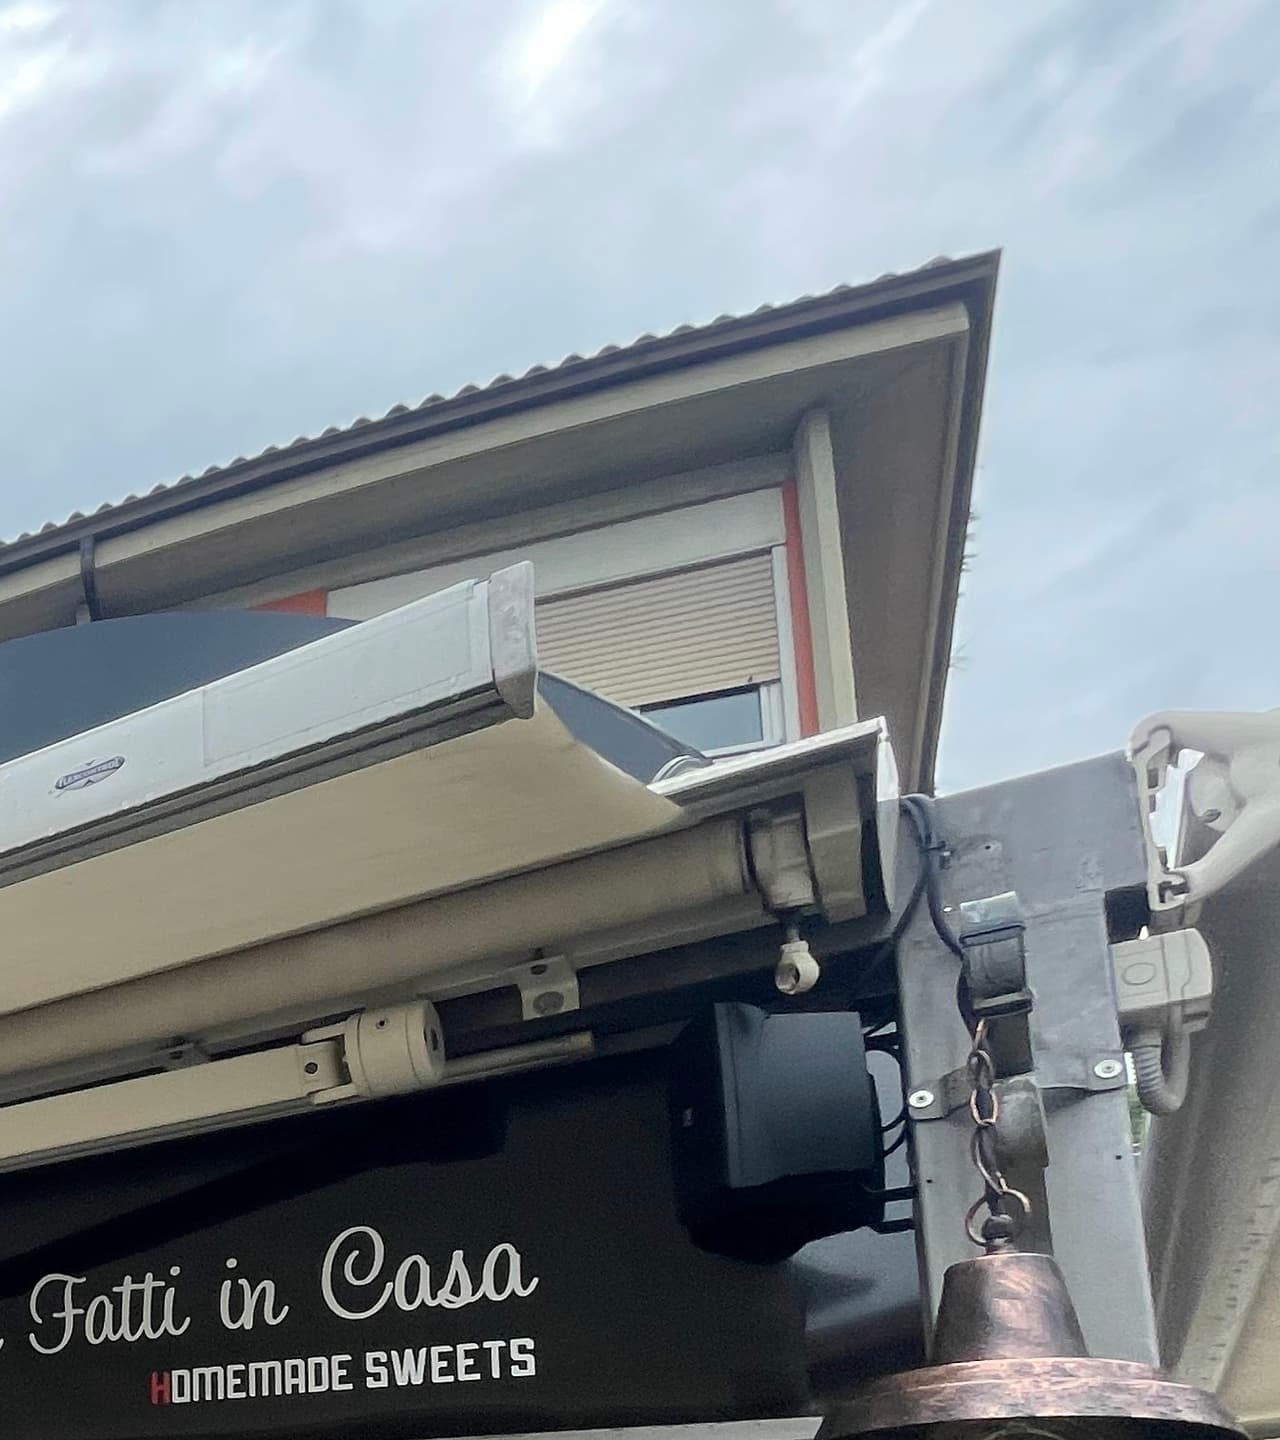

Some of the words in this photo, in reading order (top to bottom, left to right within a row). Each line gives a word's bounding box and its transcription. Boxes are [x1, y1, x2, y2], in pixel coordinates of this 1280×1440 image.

[28, 1266, 191, 1355] Fatti
[219, 1257, 289, 1330] in
[321, 1225, 539, 1319] Casa
[150, 1353, 354, 1405] HOMEMADE
[365, 1337, 536, 1389] SWEETS
